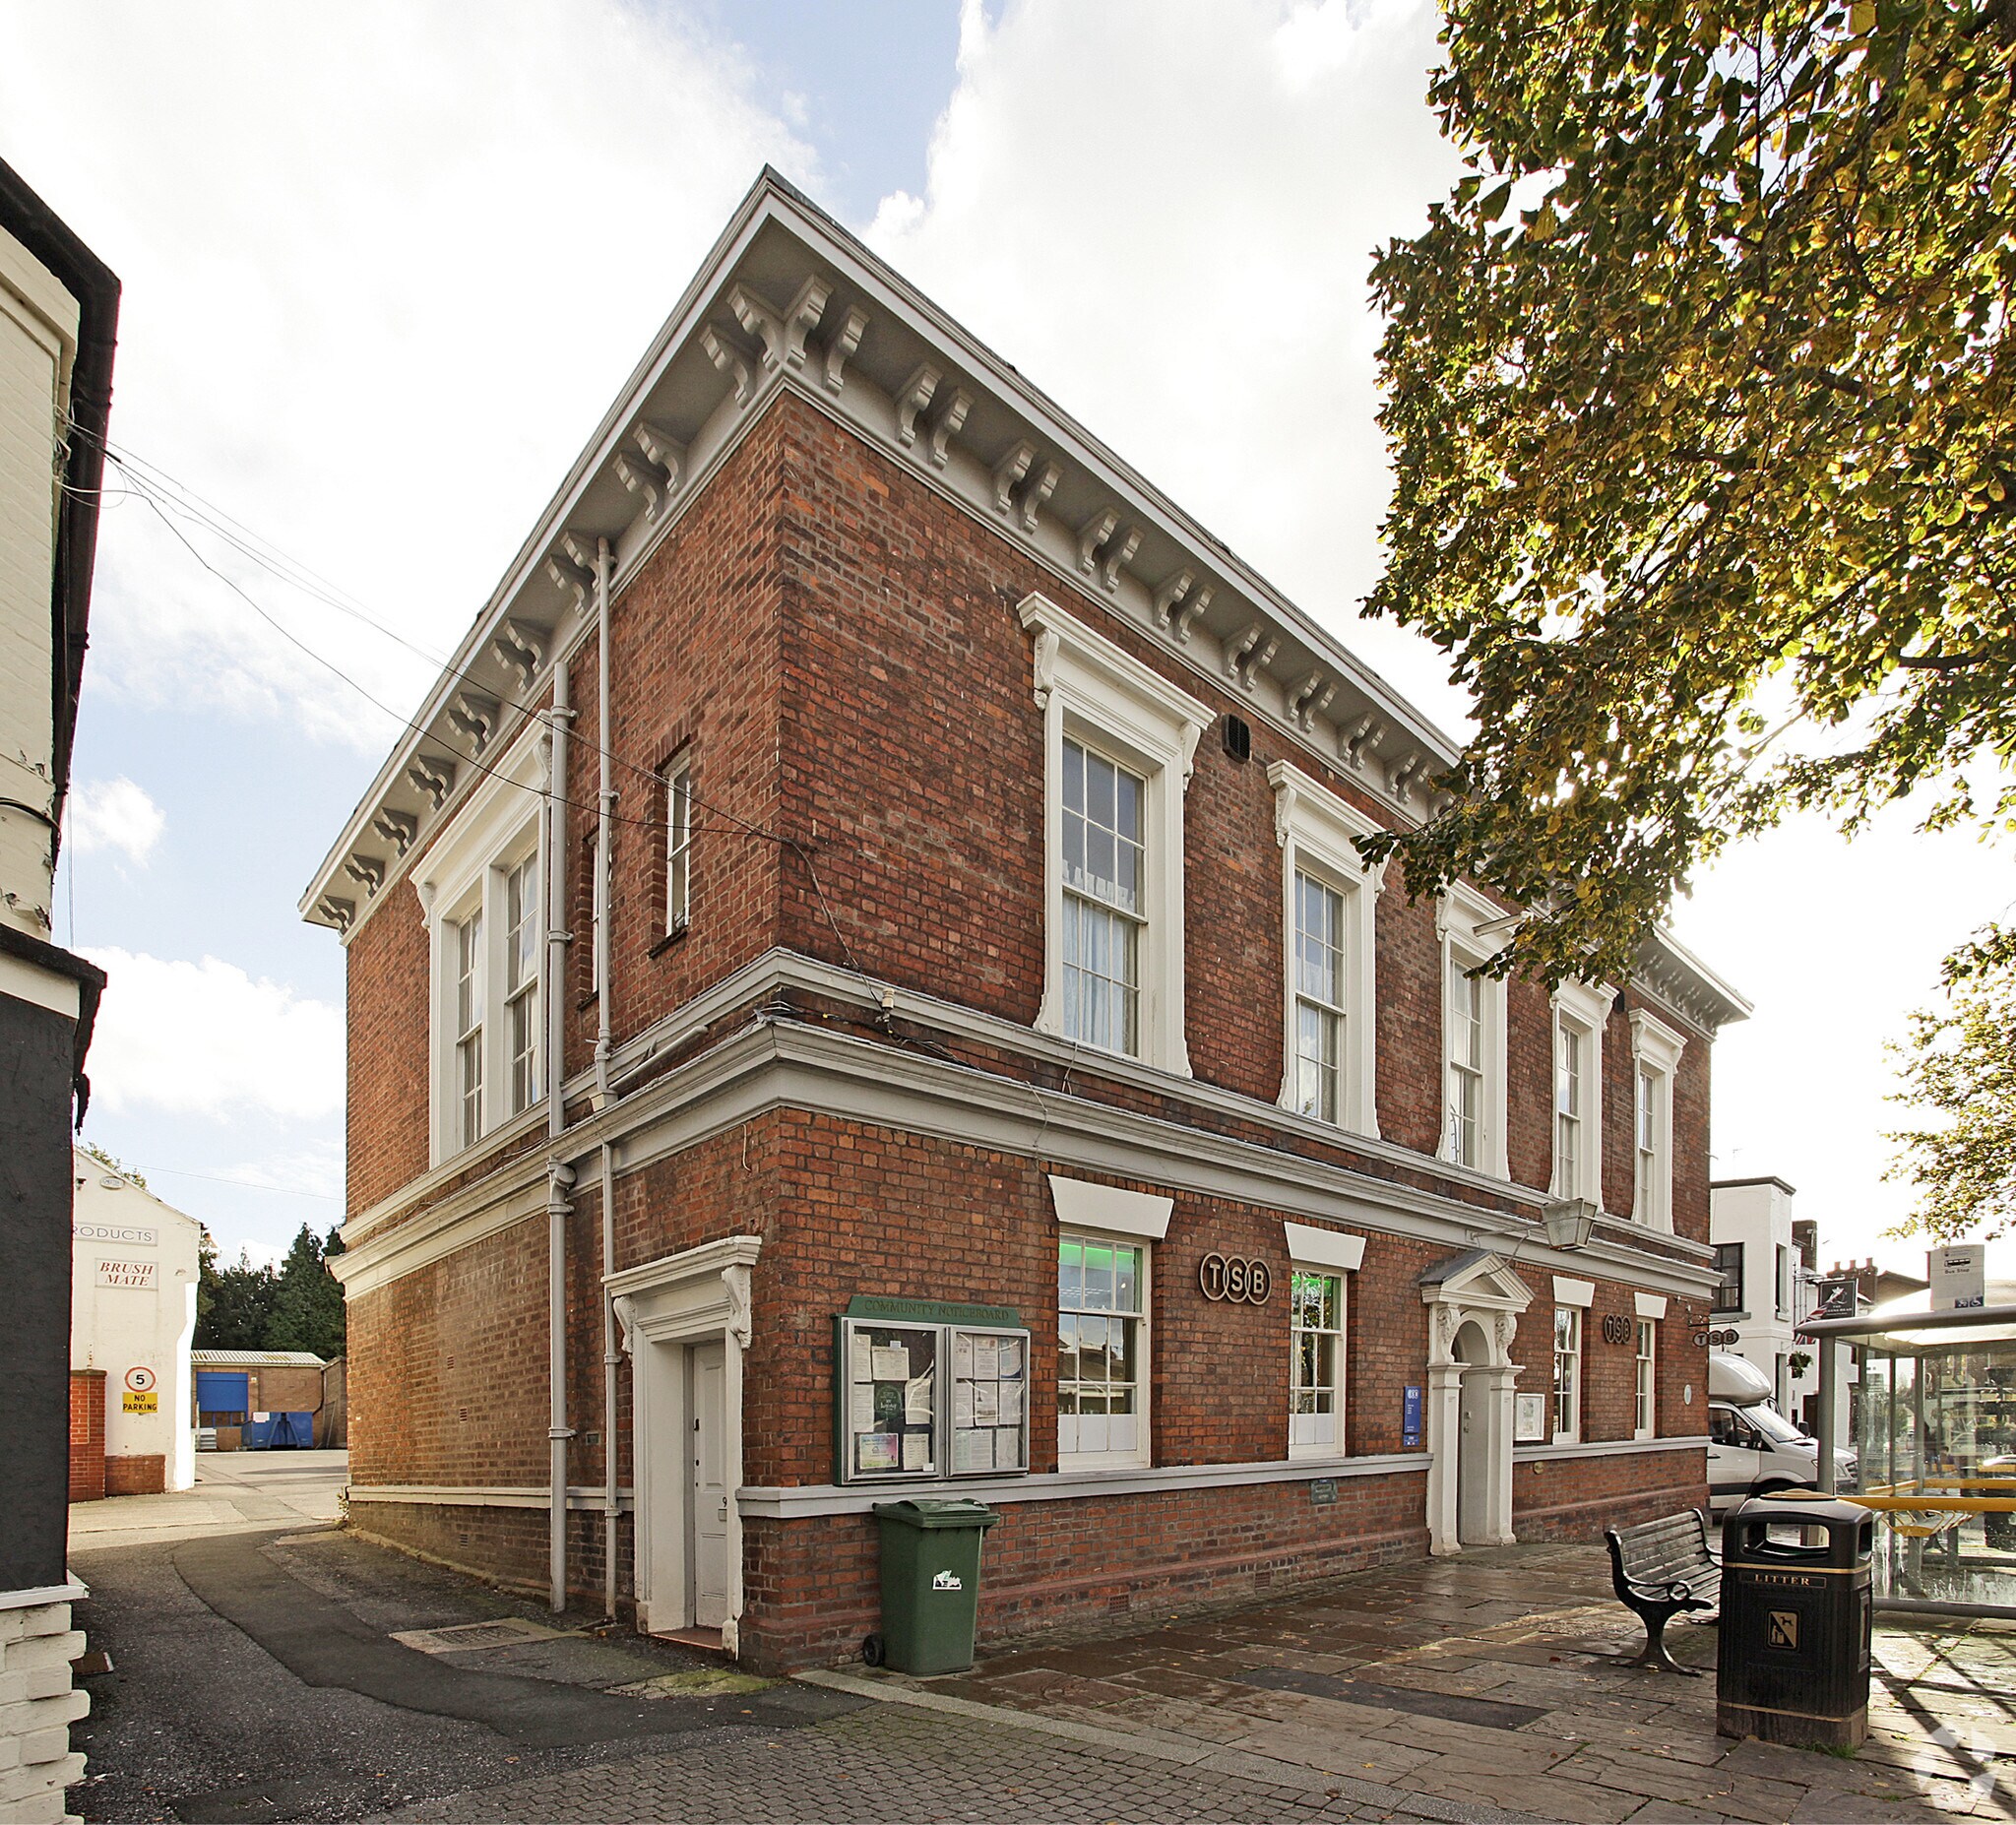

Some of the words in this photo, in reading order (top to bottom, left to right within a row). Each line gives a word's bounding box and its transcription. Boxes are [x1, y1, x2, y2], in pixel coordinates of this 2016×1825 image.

[73, 1226, 153, 1242] RODUCTS
[99, 1262, 154, 1275] BRUSH
[105, 1274, 149, 1287] MATE
[1207, 1261, 1267, 1296] TSB
[864, 1299, 934, 1315] COMMUNITY
[938, 1305, 1009, 1321] NOTICEBOARD
[1606, 1319, 1630, 1340] TSB
[1696, 1332, 1735, 1345] TSB
[136, 1374, 145, 1385] 5
[1755, 1574, 1809, 1586] LITTER
